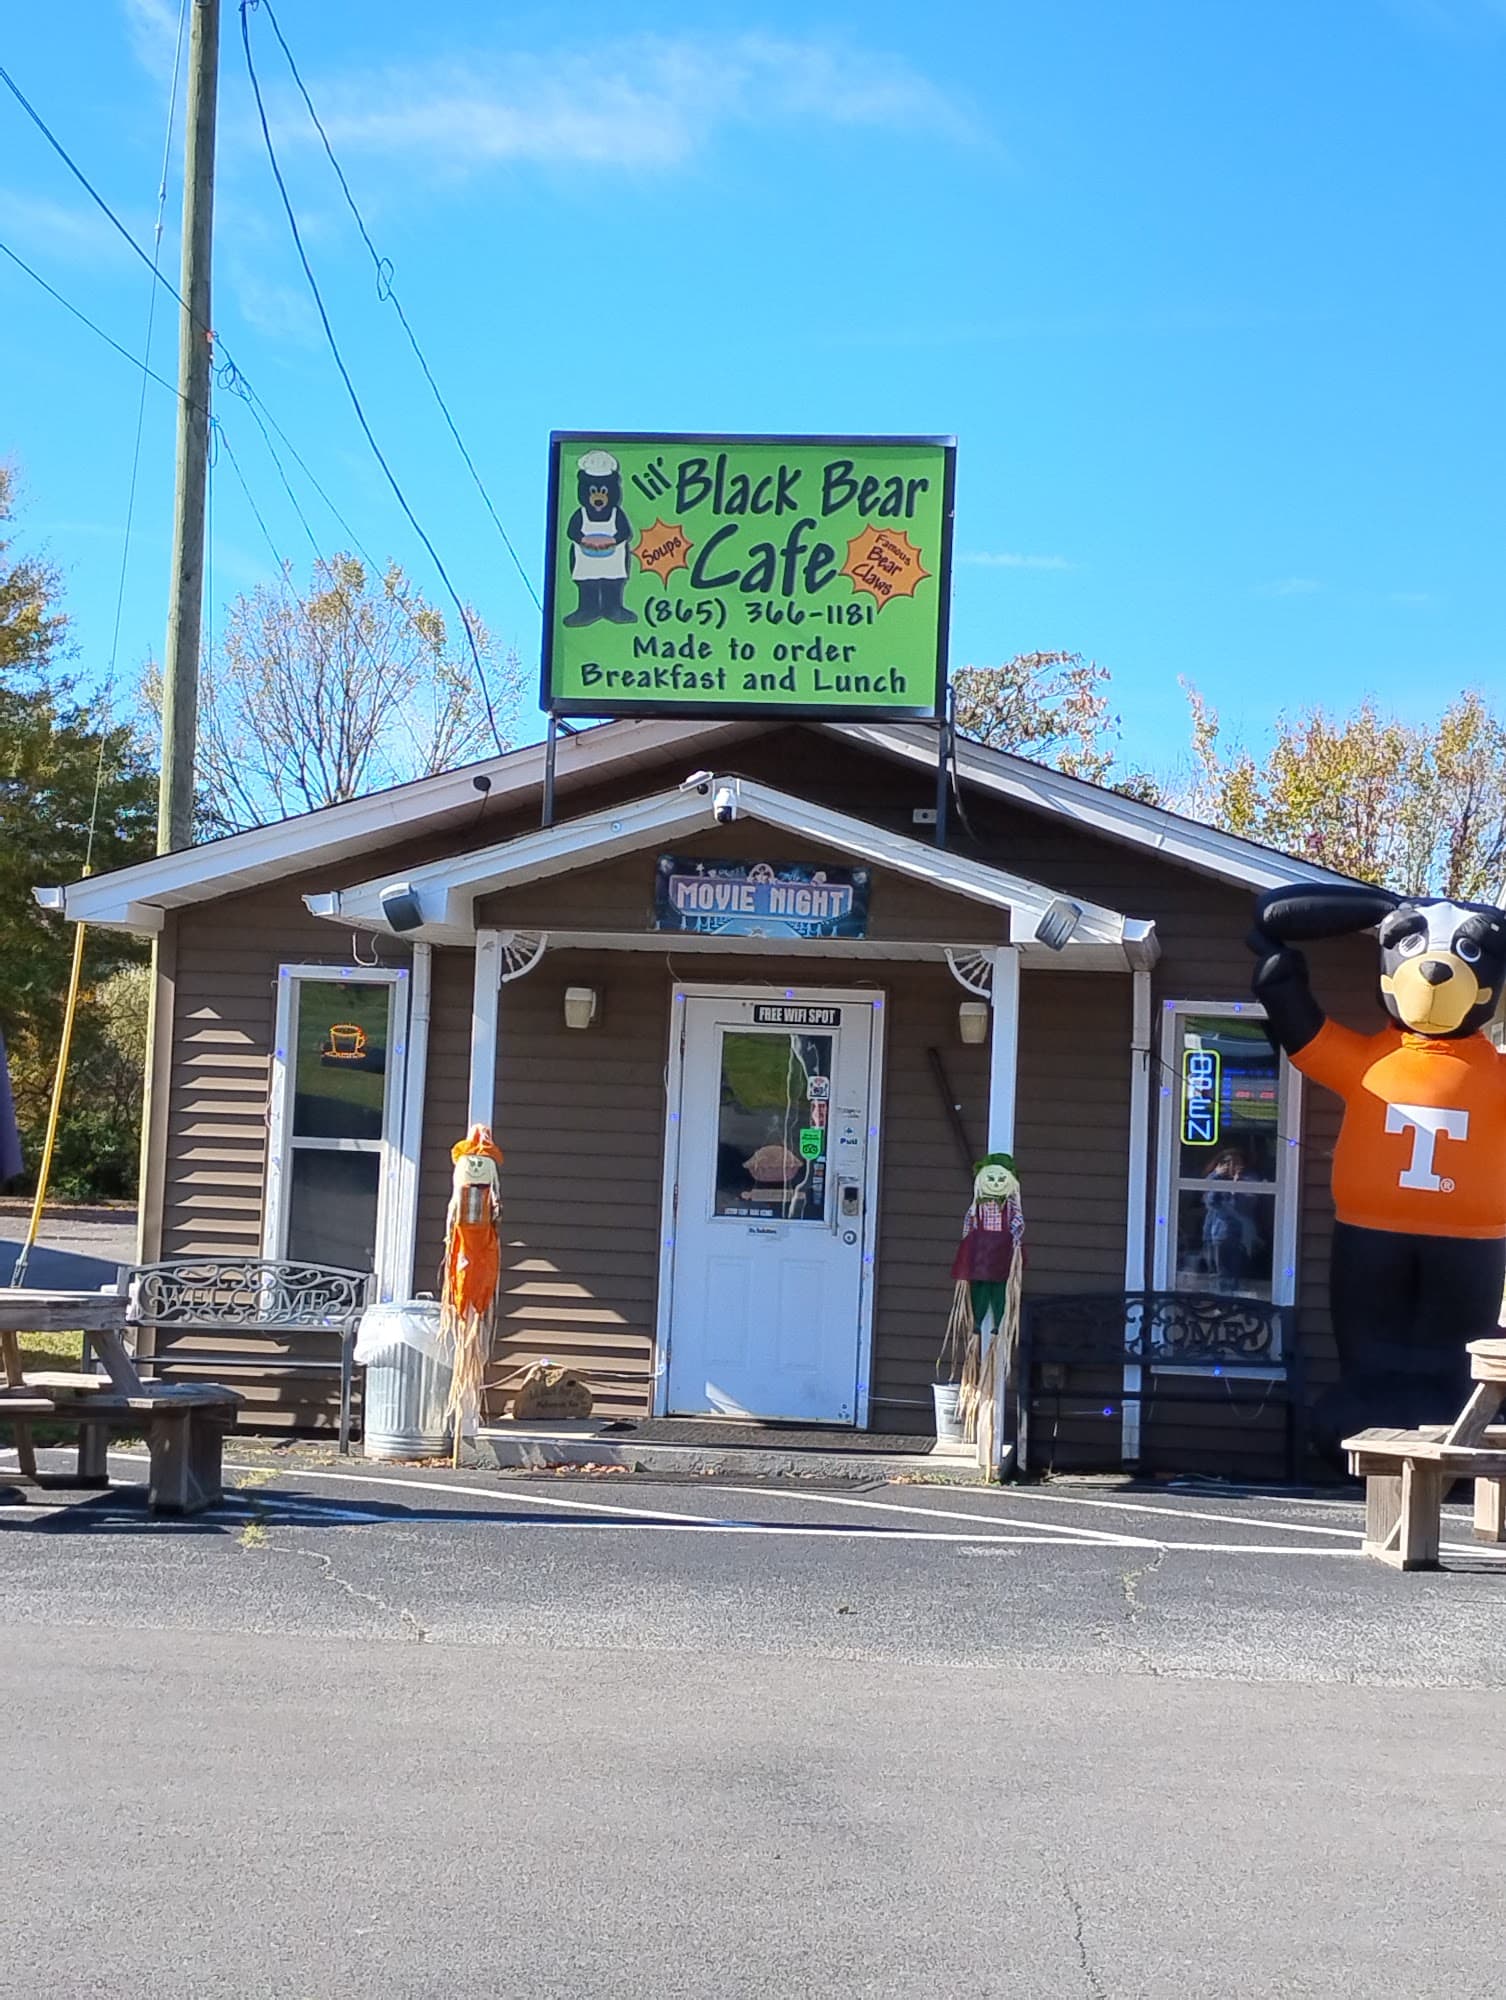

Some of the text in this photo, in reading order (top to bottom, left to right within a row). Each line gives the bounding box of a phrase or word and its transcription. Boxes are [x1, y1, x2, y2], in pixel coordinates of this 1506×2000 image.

[676, 453, 802, 515] Black
[821, 459, 929, 518] Bear
[641, 535, 682, 566] Soups
[690, 518, 837, 597] Cafe
[867, 545, 902, 576] Bear
[875, 533, 911, 566] Famous
[851, 563, 892, 595] Claws
[644, 597, 874, 628] (865) 366-1181
[633, 633, 856, 663] Made to order
[581, 663, 906, 694] Breakfast and Lunch
[677, 882, 844, 917] MOVIE NIGHT
[759, 1006, 836, 1024] FREE WIFI SPOT
[1188, 1056, 1212, 1140] OPEN
[156, 1283, 333, 1314] WELCOME
